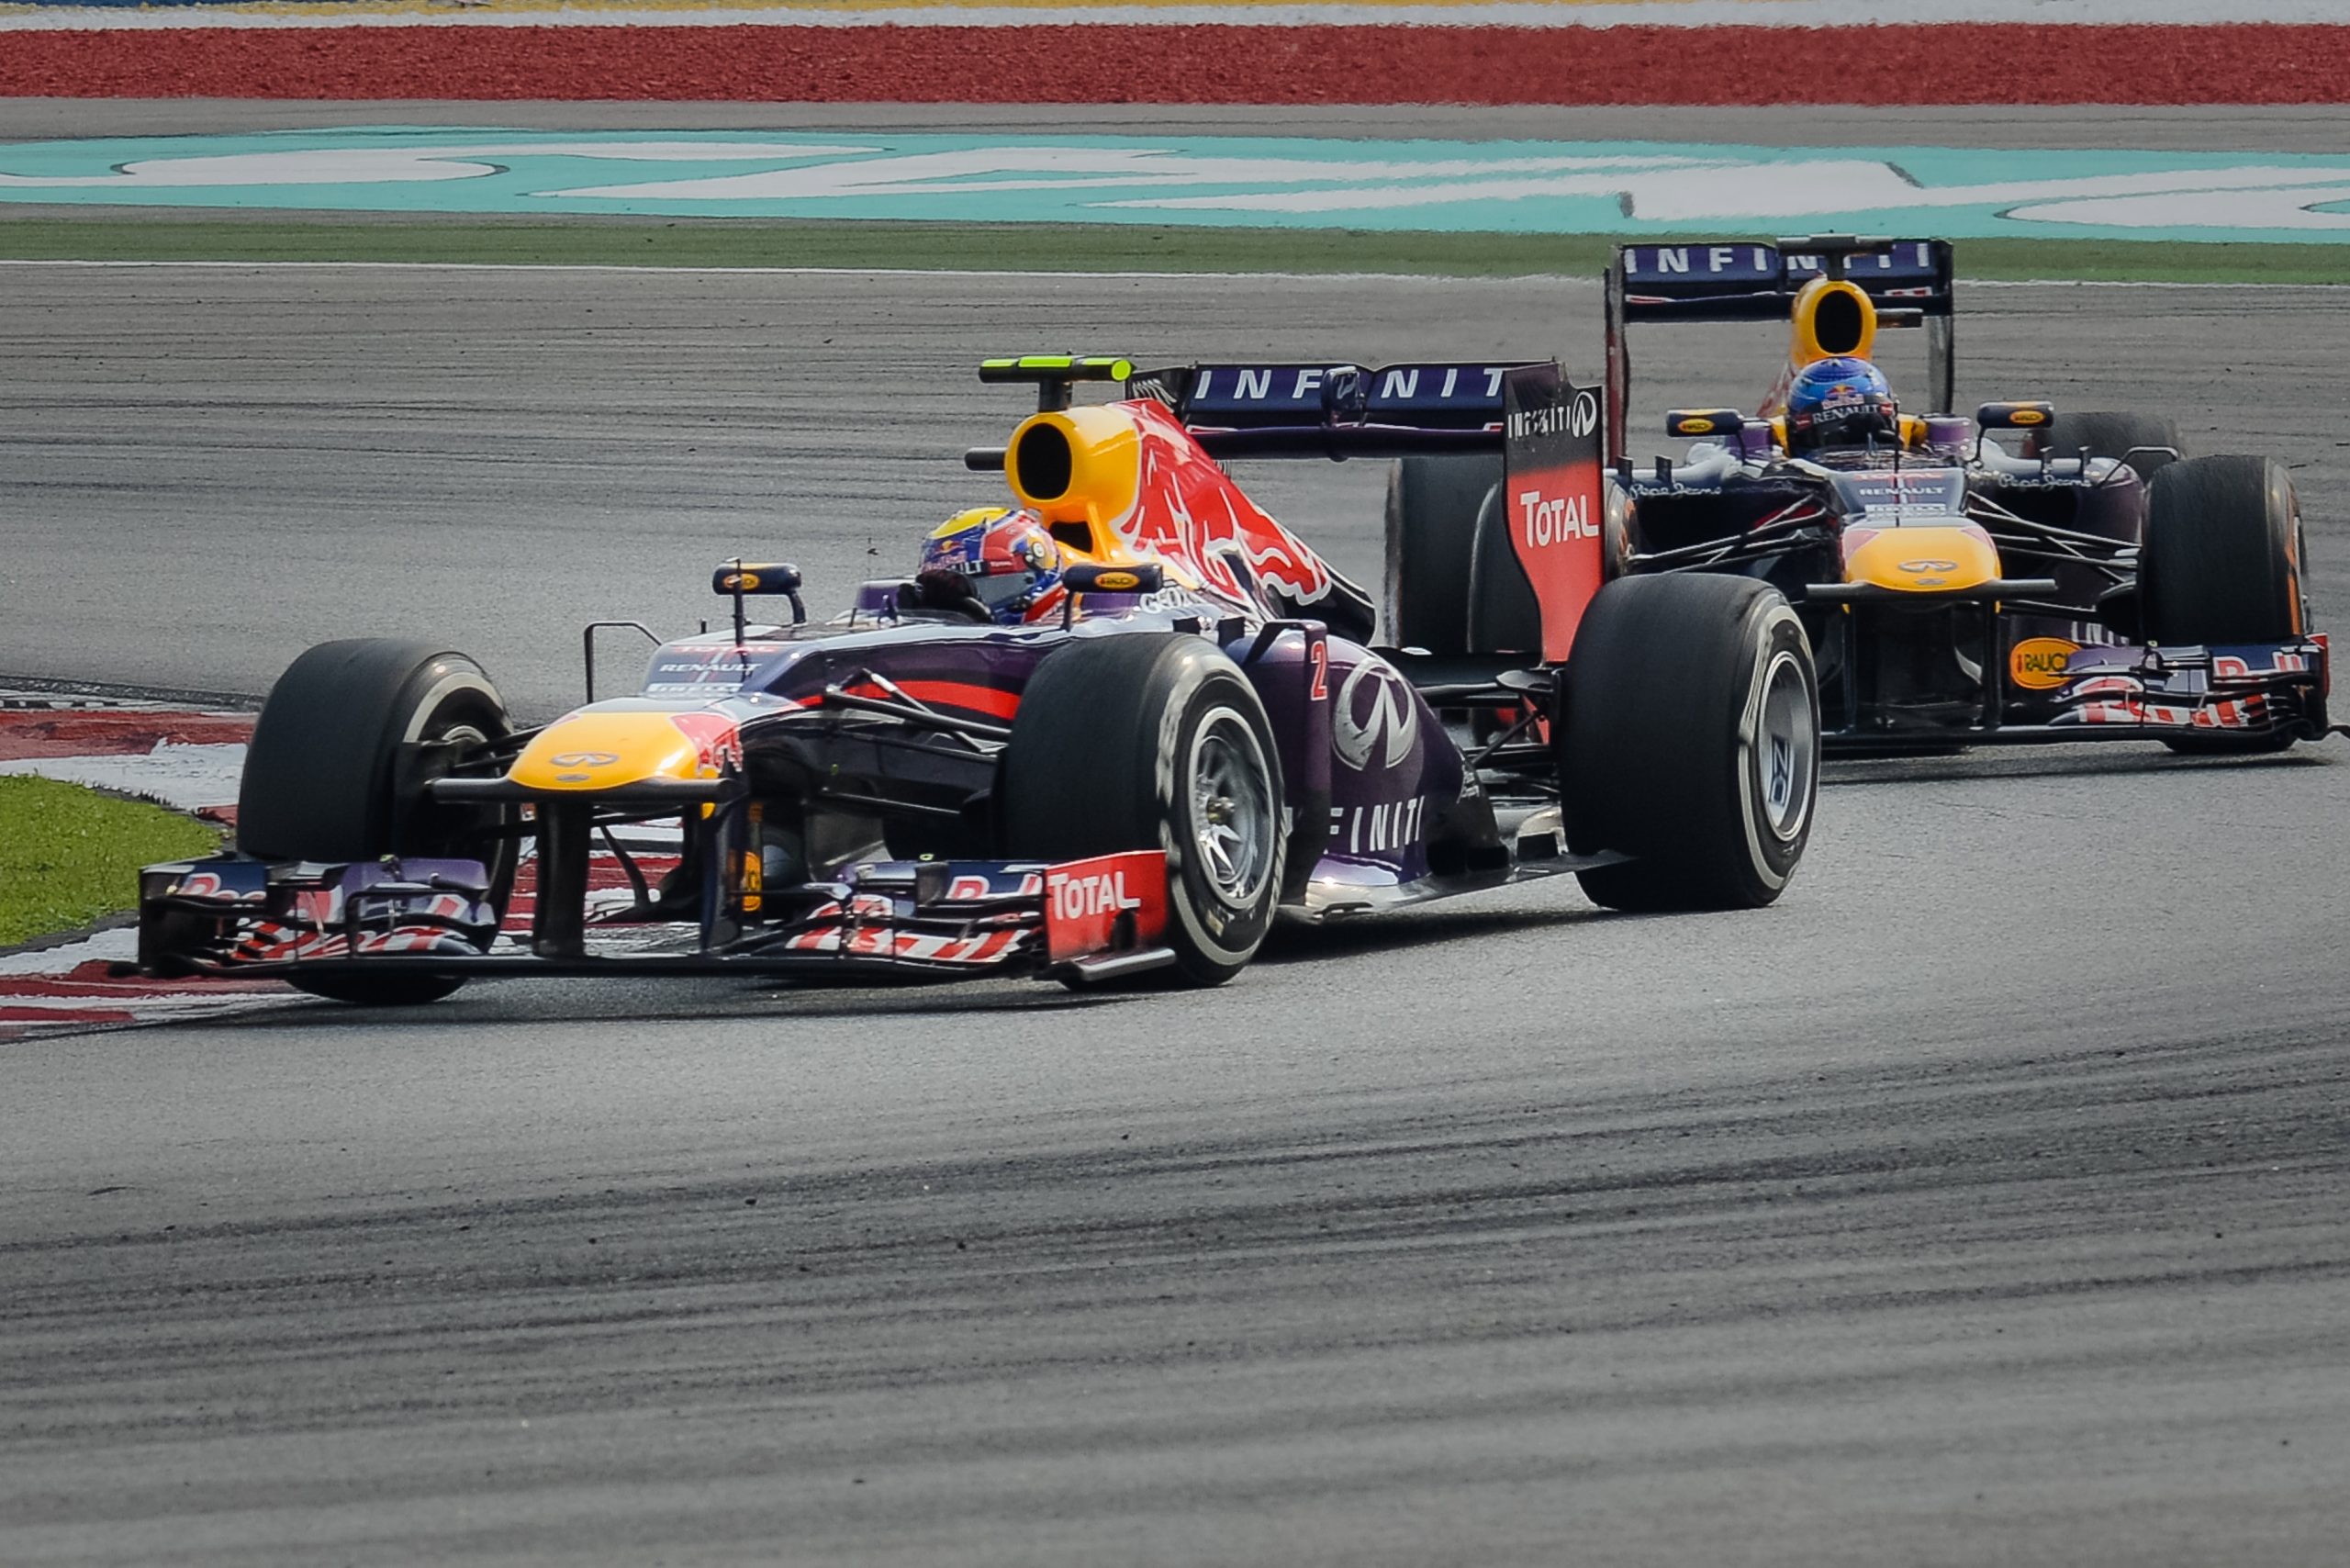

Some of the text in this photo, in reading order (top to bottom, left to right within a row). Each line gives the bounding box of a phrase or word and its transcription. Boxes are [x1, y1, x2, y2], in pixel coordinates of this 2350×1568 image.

[1812, 405, 1878, 424] RENAULT
[1859, 487, 1946, 496] RENAULT
[1520, 490, 1599, 548] TOTAL
[659, 663, 762, 673] RENAULT
[1311, 640, 1327, 701] 2
[1047, 871, 1141, 921] TOTAL
